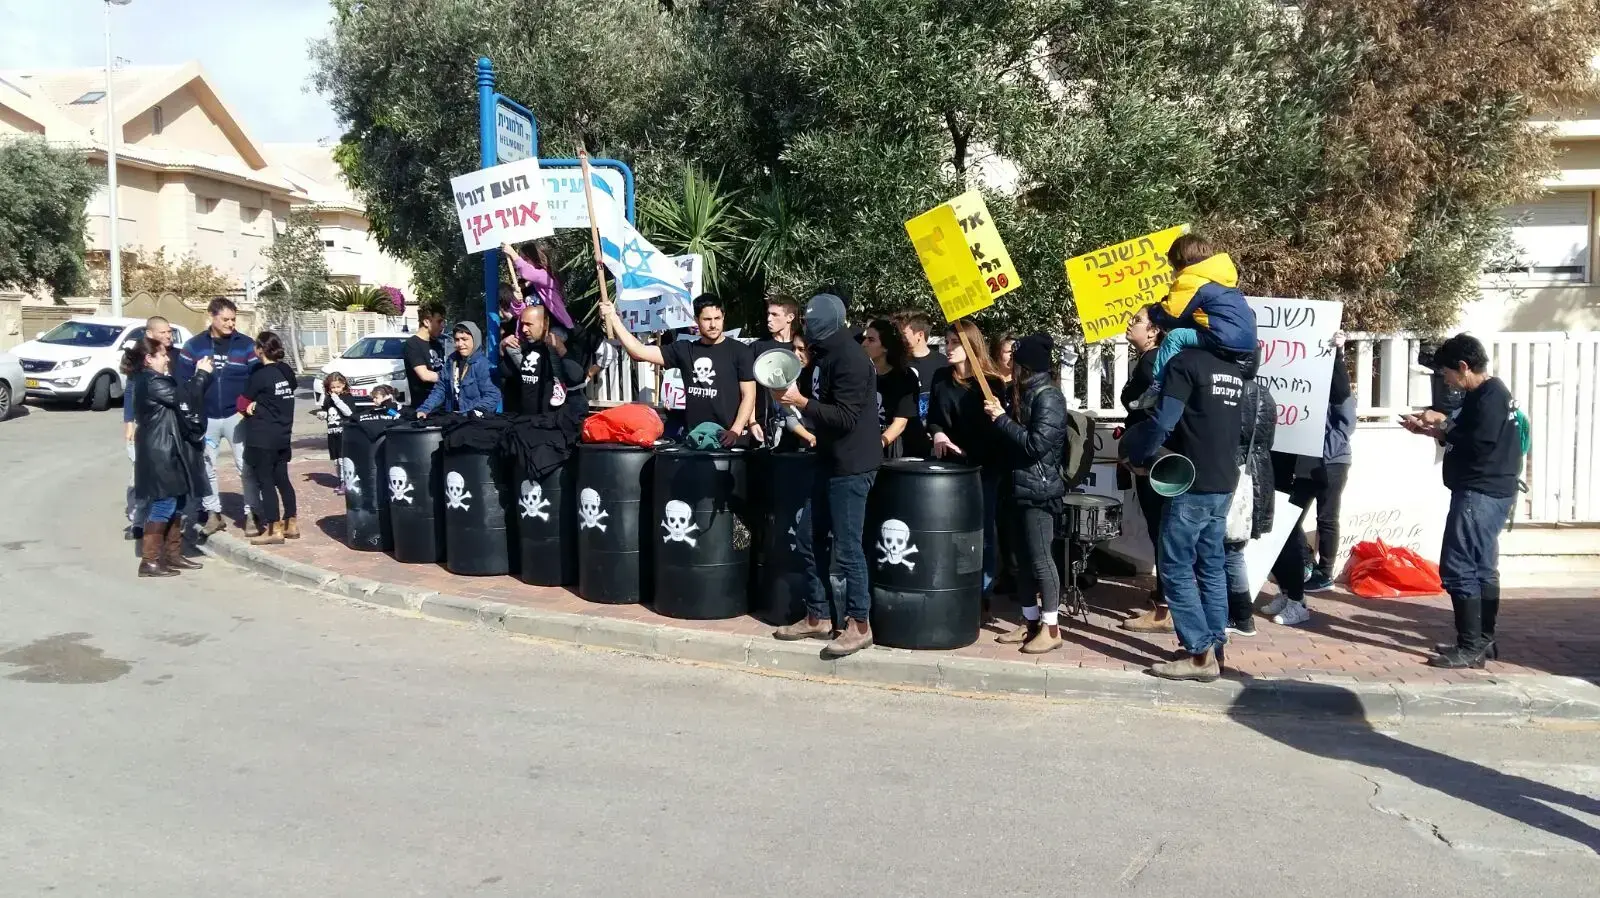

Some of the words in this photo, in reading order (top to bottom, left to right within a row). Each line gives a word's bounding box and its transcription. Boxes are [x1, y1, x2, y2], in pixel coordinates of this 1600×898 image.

[455, 186, 486, 209] דורש
[490, 174, 530, 199] העם
[494, 201, 541, 229] אויר
[466, 213, 494, 246] נקי
[1083, 237, 1155, 272] תשובה
[985, 272, 1009, 294] 20
[1137, 270, 1173, 292] ותנו
[1104, 290, 1155, 312] האסדה
[1257, 305, 1316, 331] תשוב
